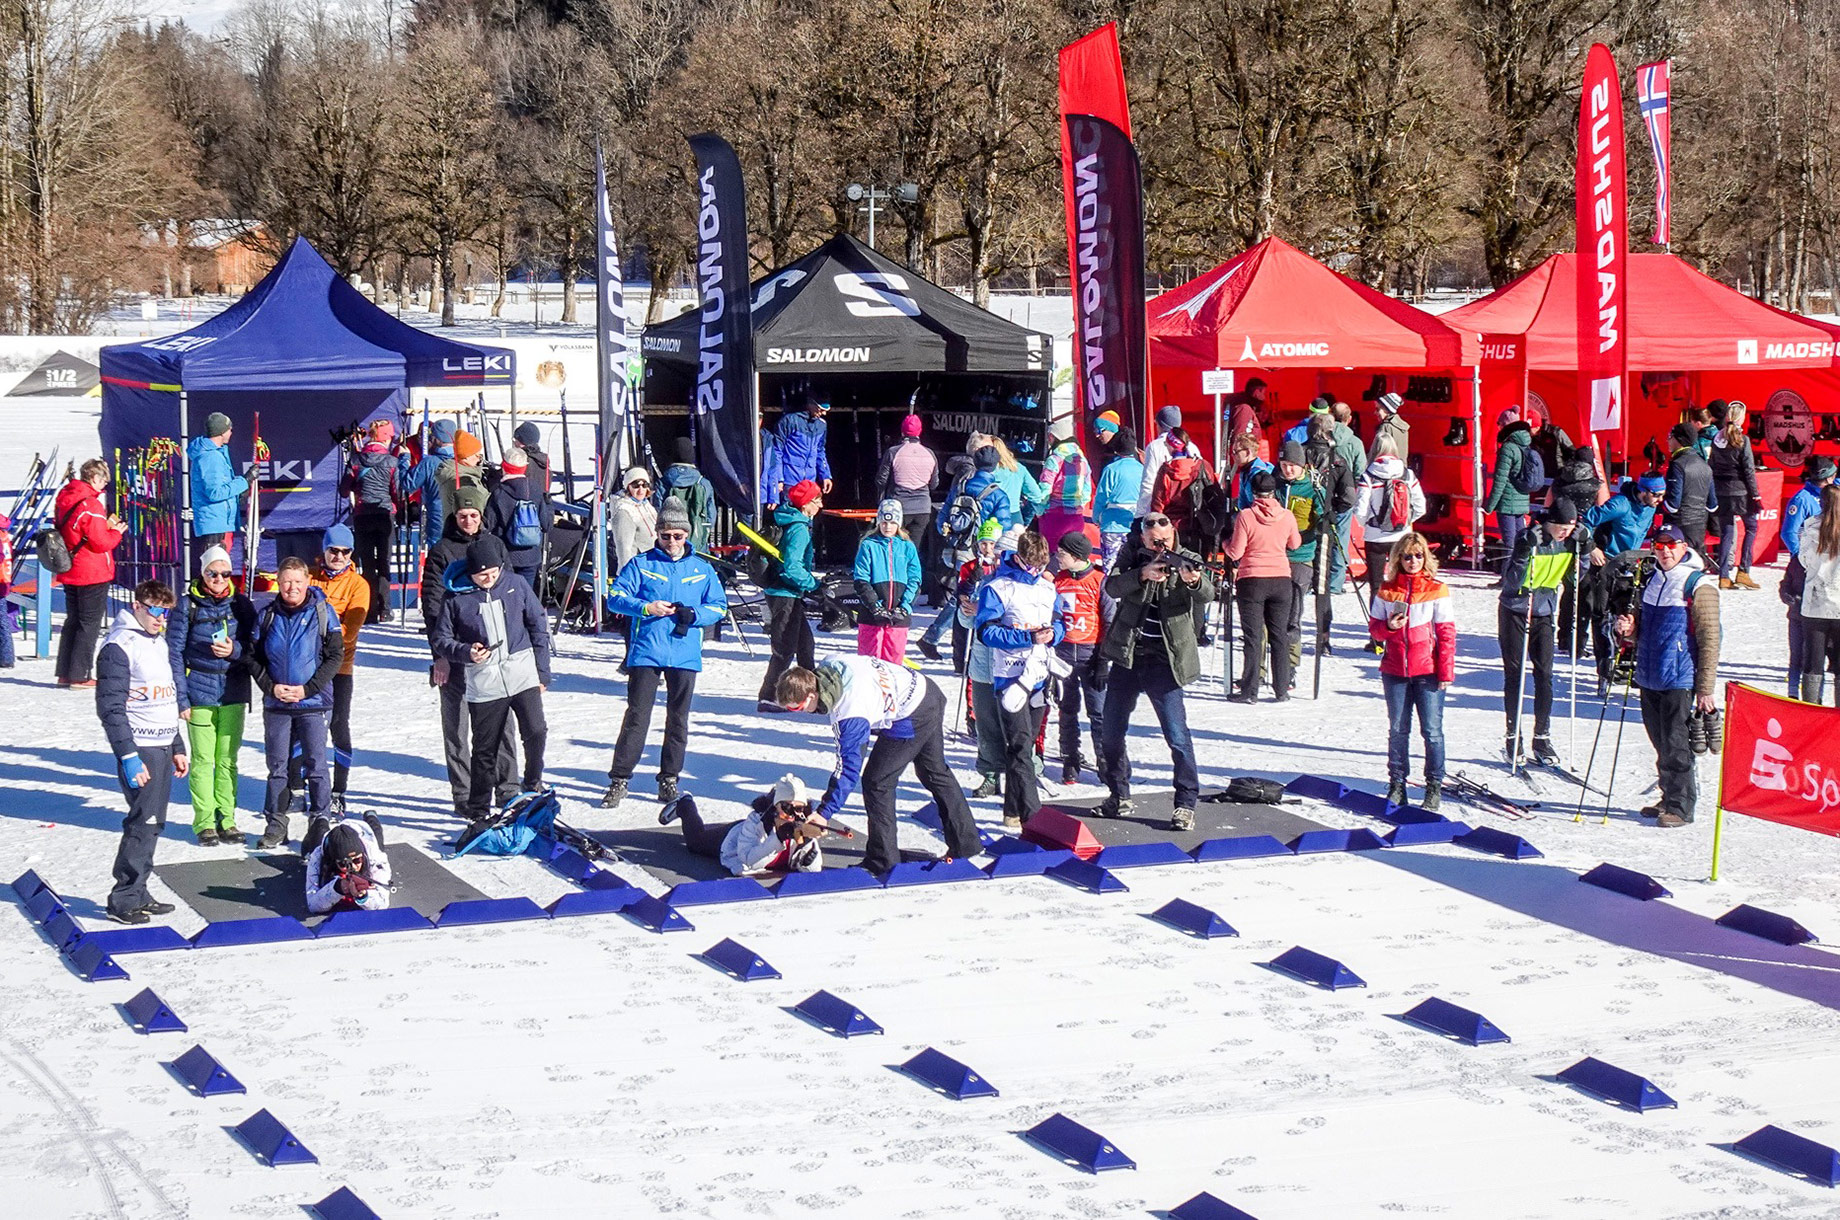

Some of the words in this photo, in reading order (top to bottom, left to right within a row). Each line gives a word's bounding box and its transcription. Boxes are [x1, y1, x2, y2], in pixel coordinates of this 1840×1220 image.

[643, 337, 681, 353] SALOMON
[1260, 343, 1329, 357] ATOMIC
[443, 355, 511, 372] LEKI
[767, 347, 870, 364] SALOMON
[52, 369, 77, 381] 1/2
[932, 413, 999, 435] SALOMON
[1773, 421, 1805, 429] MADSHUS
[243, 460, 312, 481] EKI
[1756, 509, 1777, 520] US
[1064, 615, 1088, 632] 34
